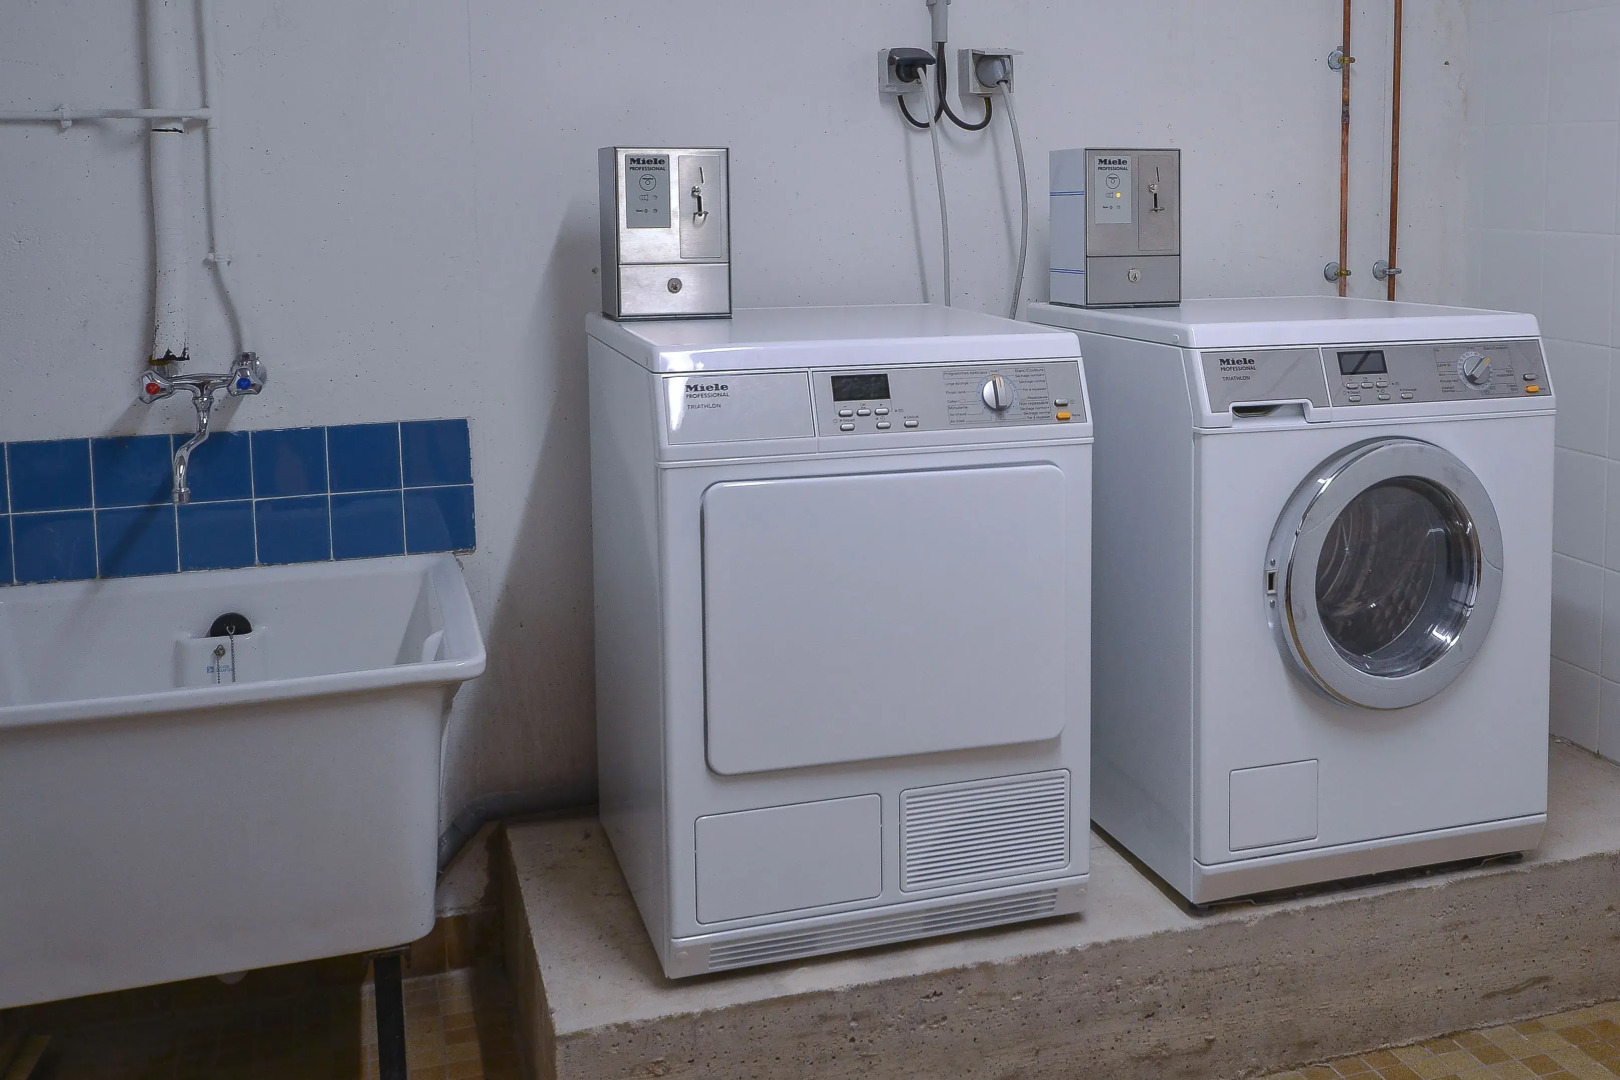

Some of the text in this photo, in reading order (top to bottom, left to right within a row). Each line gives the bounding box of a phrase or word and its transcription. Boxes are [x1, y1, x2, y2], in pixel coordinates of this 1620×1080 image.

[629, 157, 666, 165] Miele
[1219, 357, 1255, 366] Miele
[685, 383, 729, 392] Miele
